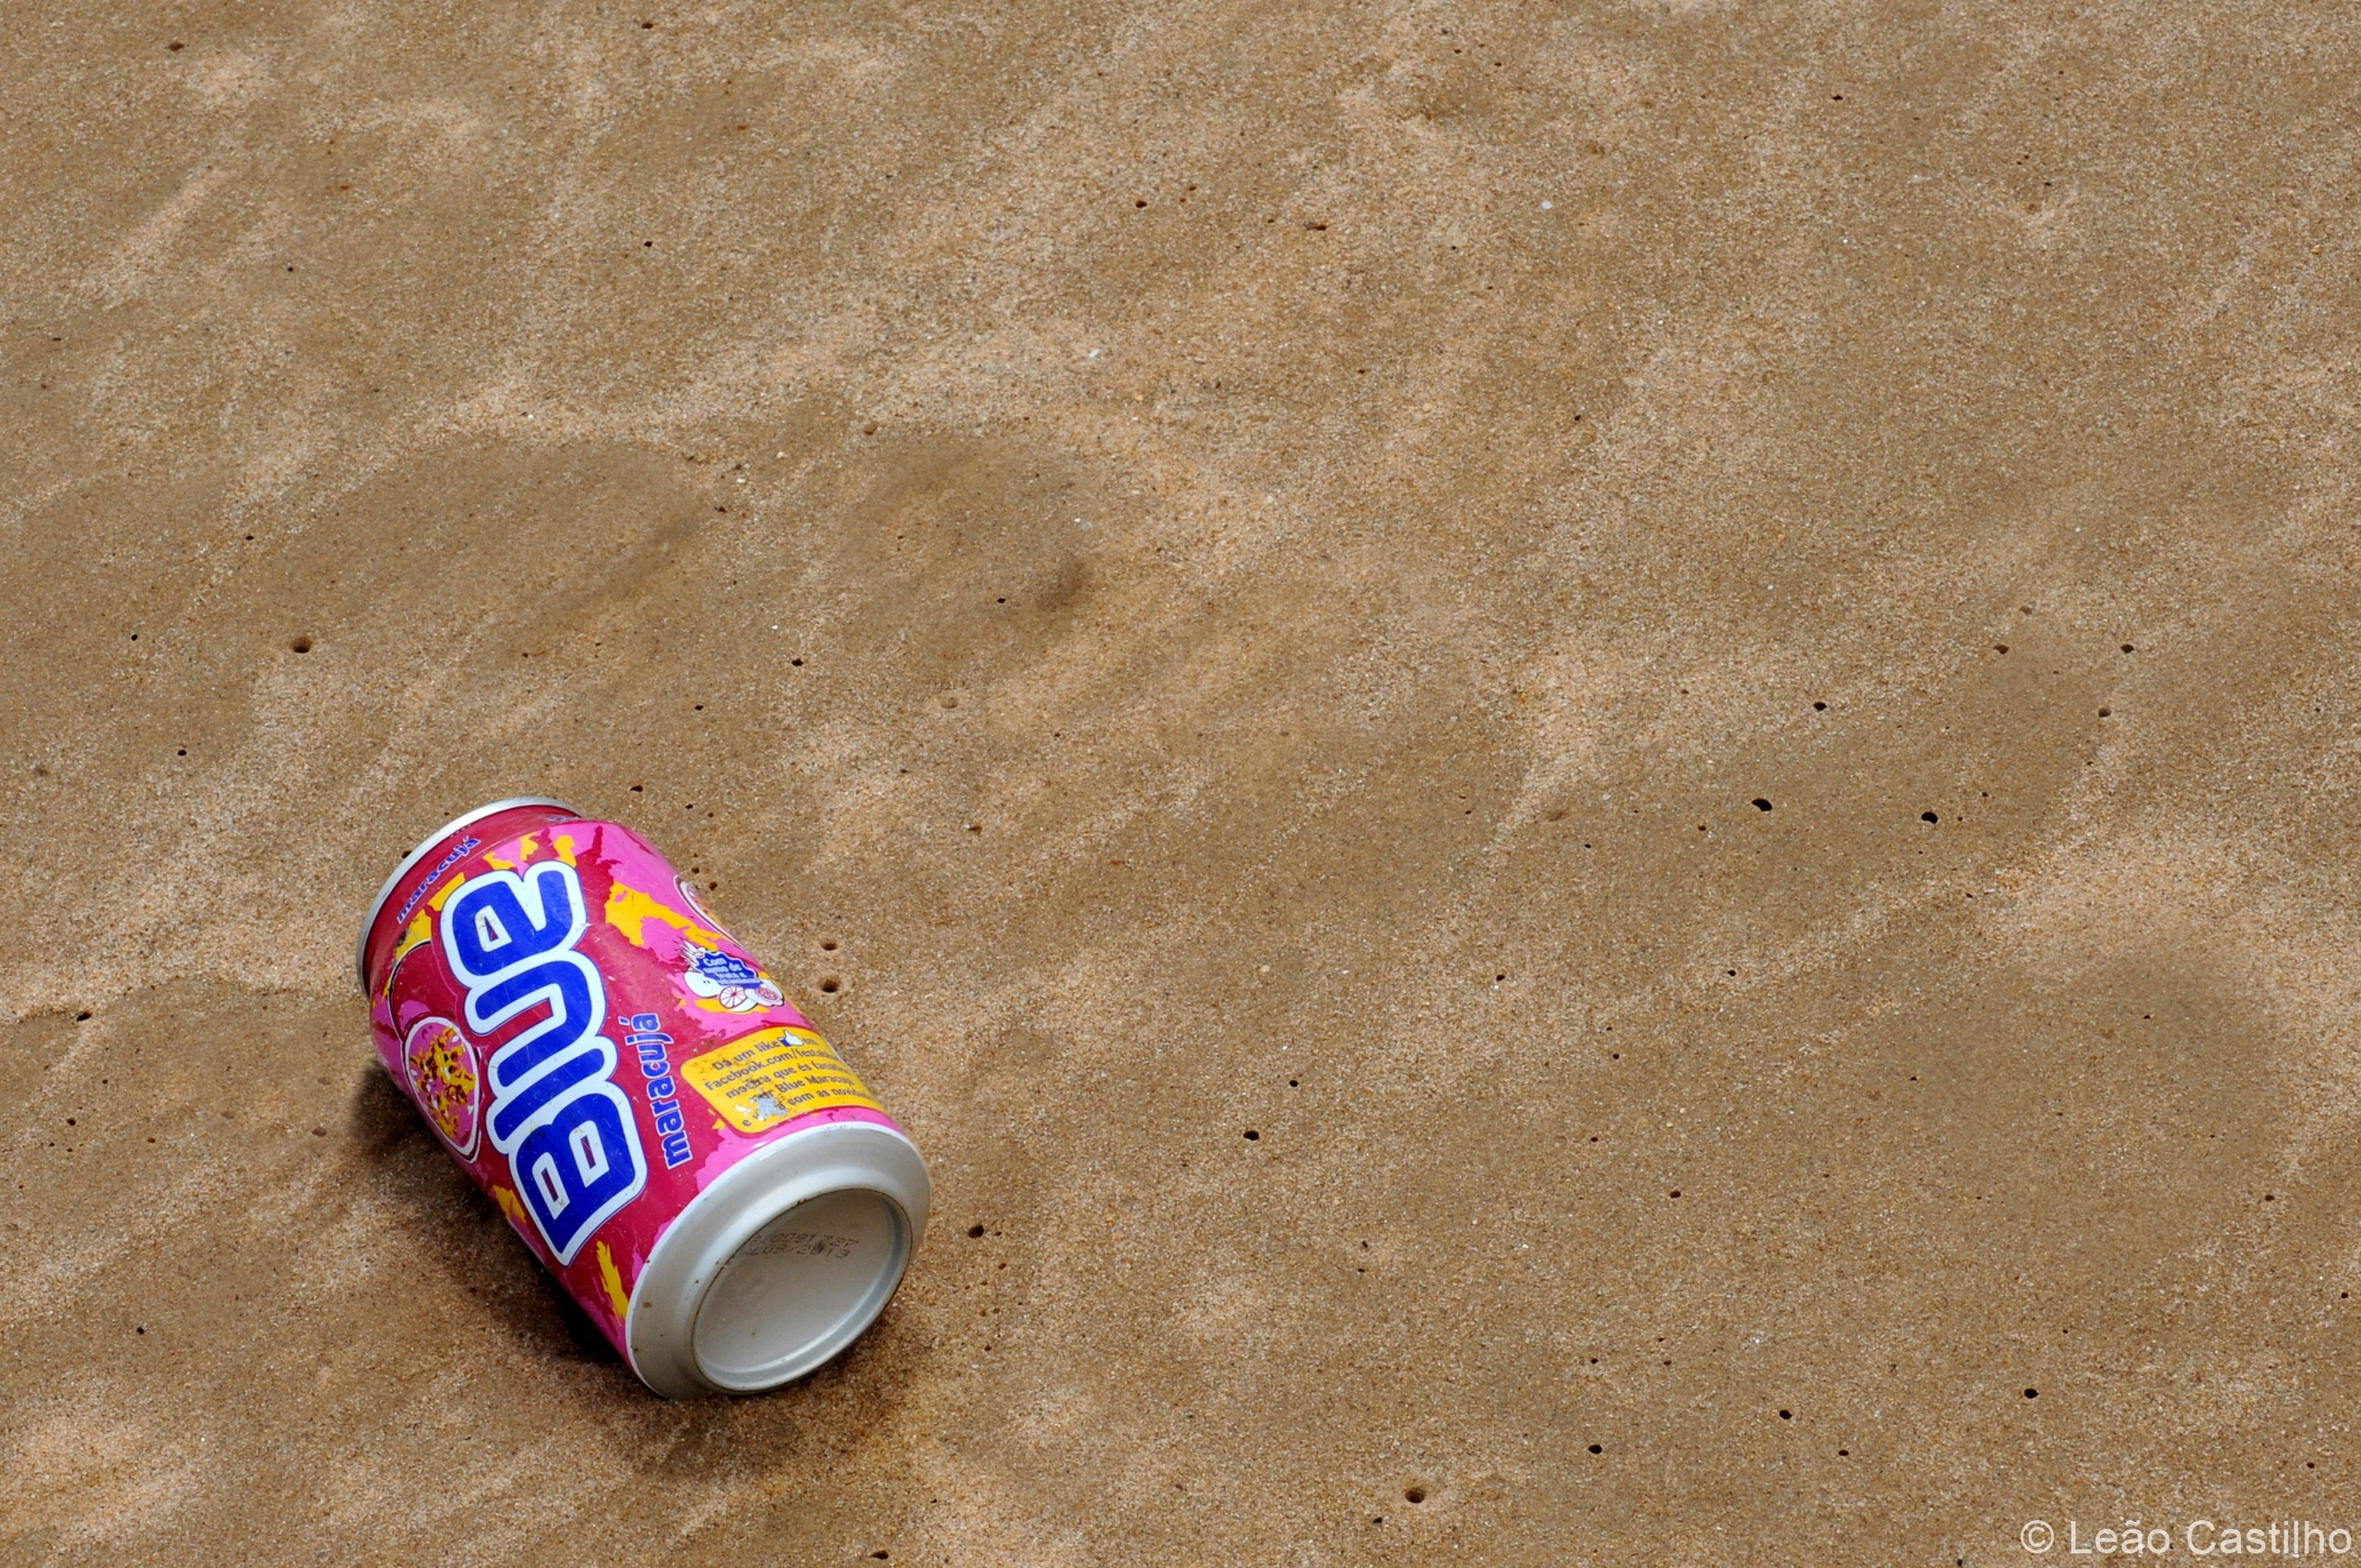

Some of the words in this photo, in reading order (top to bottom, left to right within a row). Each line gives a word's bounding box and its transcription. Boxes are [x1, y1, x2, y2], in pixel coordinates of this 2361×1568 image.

[397, 836, 481, 924] maracujá
[734, 1050, 755, 1063] um
[754, 1040, 781, 1052] like
[441, 861, 647, 1266] Blue
[774, 1066, 797, 1080] que
[618, 1013, 694, 1170] maracujá
[775, 1079, 806, 1094] Blue
[788, 1091, 814, 1106] com
[816, 1089, 830, 1098] as
